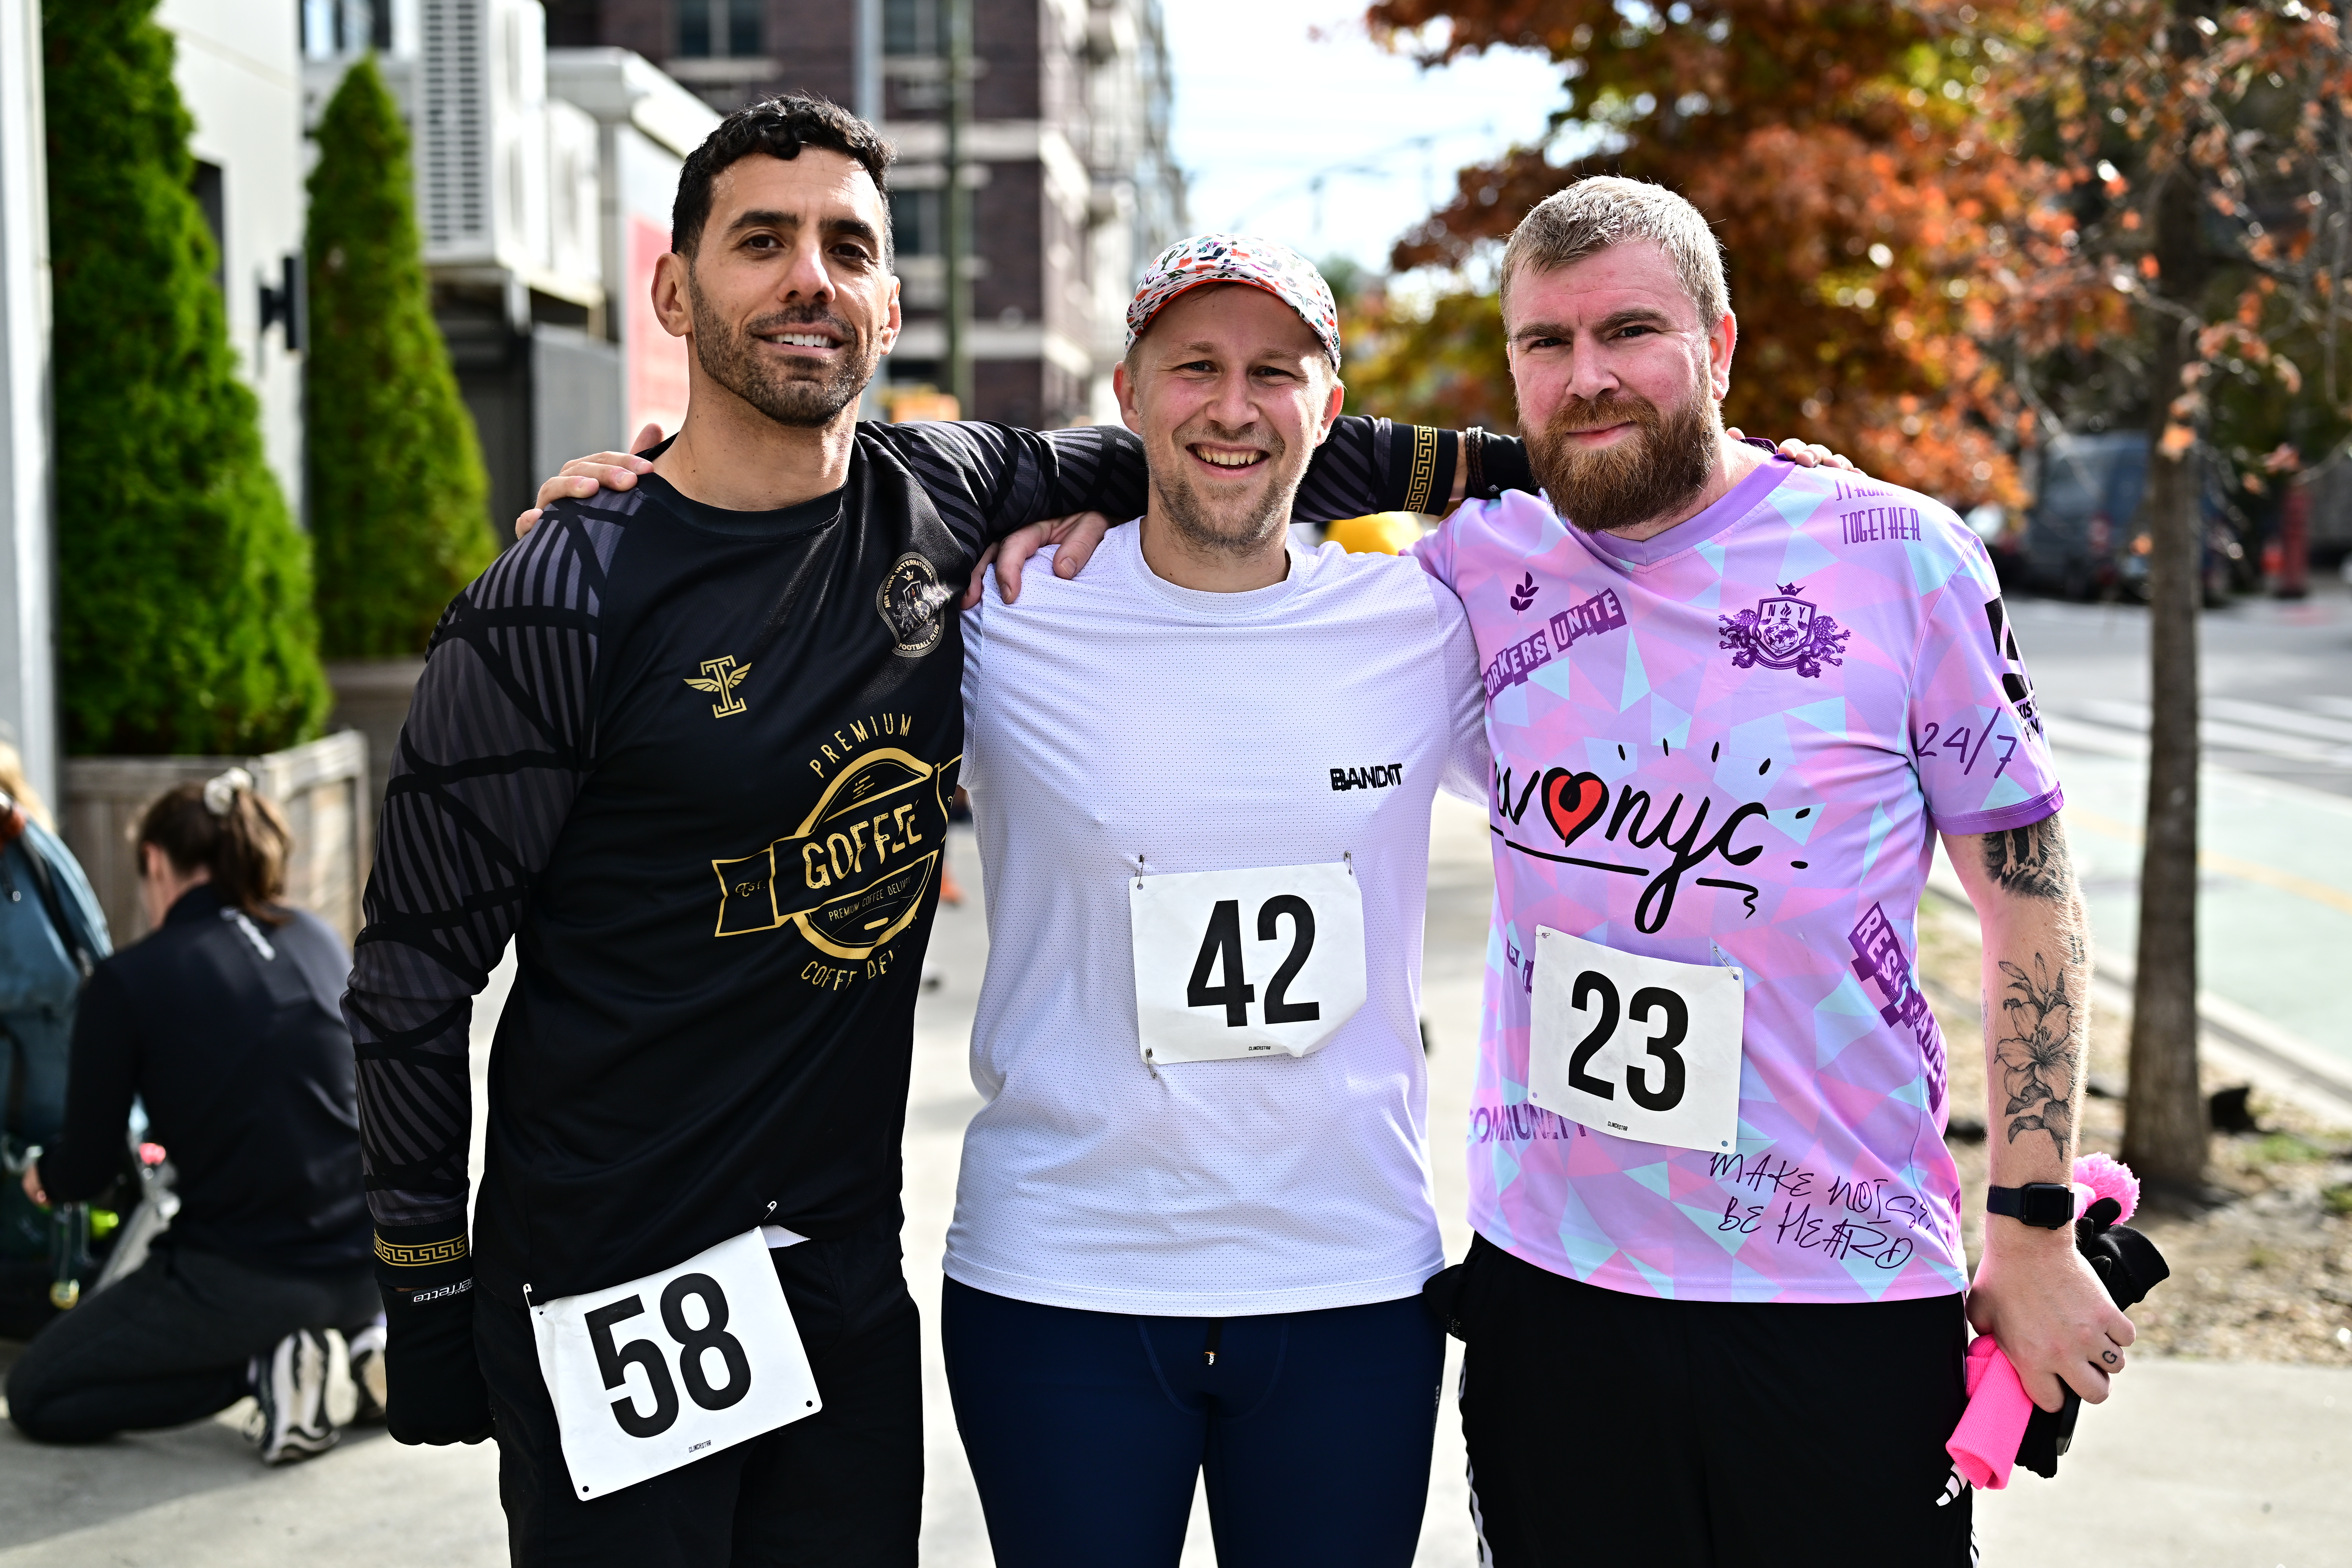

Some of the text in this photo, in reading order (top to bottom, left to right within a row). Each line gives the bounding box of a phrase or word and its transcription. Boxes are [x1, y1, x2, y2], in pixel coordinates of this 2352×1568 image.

[1840, 507, 1921, 544] TOGETHER
[884, 575, 897, 595] YORK
[895, 560, 933, 582] INTERNATIONAL
[898, 624, 940, 650] FOOTBALL CLUB
[1555, 592, 1619, 645] UNITE
[809, 713, 911, 778] PREMIUM
[1917, 707, 2018, 778] 24/7
[1330, 763, 1402, 791] BANDIT
[828, 902, 860, 921] PREMIUM
[862, 889, 884, 907] COFFEE
[1187, 894, 1320, 1027] 42
[1568, 971, 1688, 1111] 23
[1608, 1121, 1628, 1131] CLINCHSTAR
[1710, 1152, 1814, 1197] MAKE
[1718, 1196, 1764, 1233] BE
[1777, 1202, 1914, 1269] HEARD
[584, 1273, 751, 1438] 58
